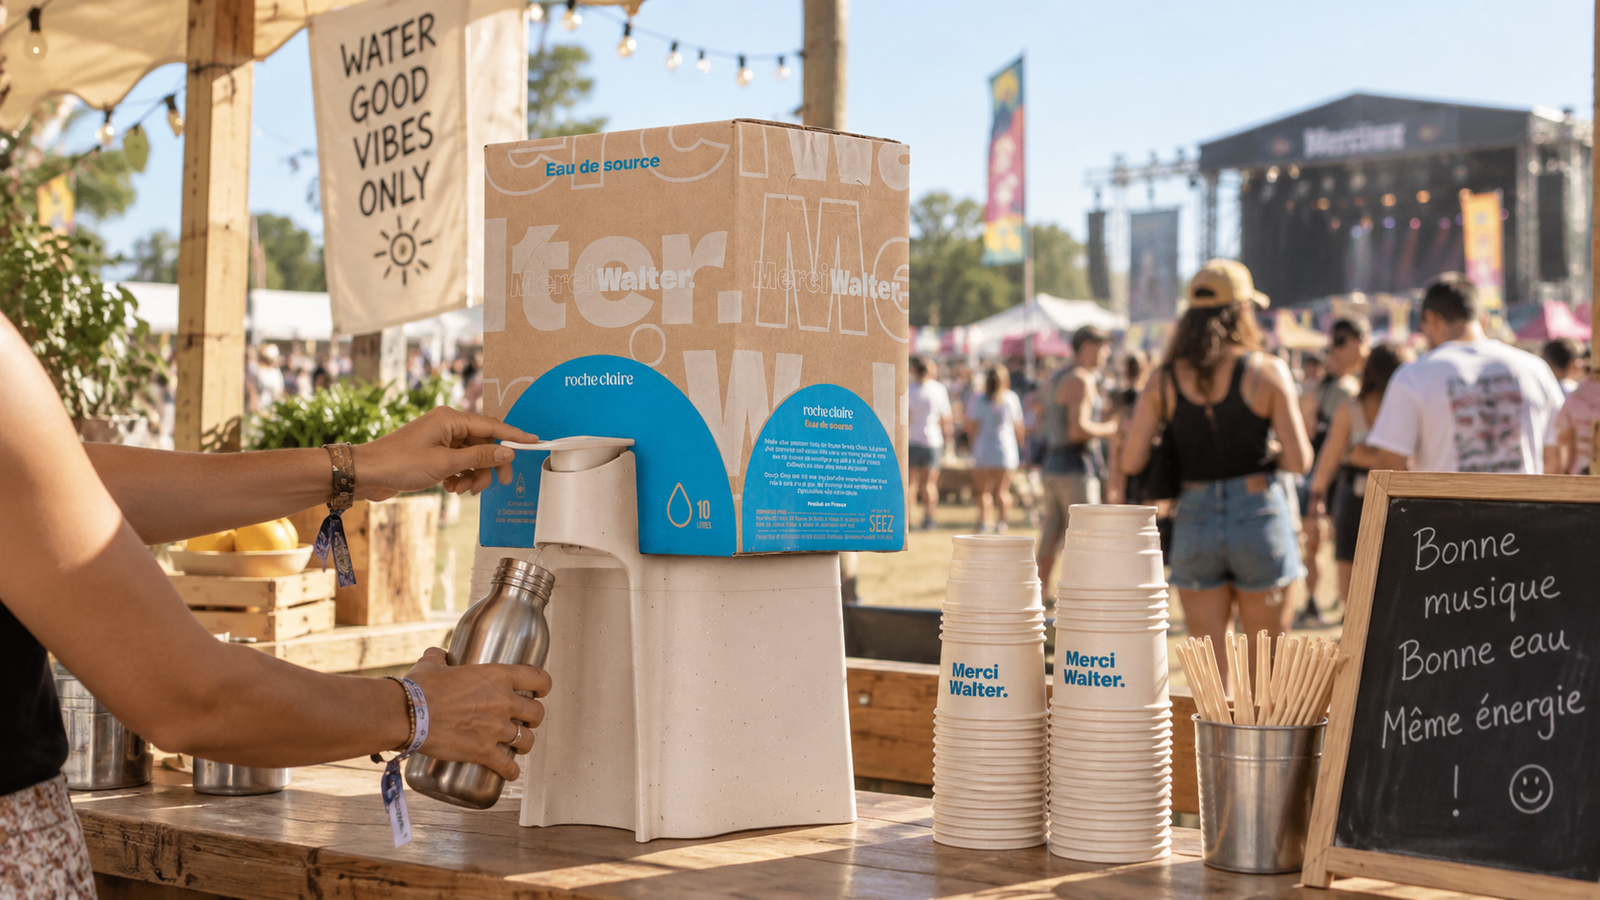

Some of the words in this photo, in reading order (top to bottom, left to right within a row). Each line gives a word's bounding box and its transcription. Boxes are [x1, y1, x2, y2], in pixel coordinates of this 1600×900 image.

[341, 12, 437, 78] WATER
[350, 66, 429, 124] GOOD
[353, 111, 434, 170] VIBES
[546, 162, 575, 177] Eau
[579, 159, 600, 174] de
[603, 156, 661, 172] source
[359, 160, 430, 217] ONLY
[565, 373, 598, 387] roche
[600, 372, 634, 386] claire
[696, 499, 711, 520] 10
[869, 514, 895, 533] SEEZ
[1414, 527, 1519, 572] Bonne
[1424, 576, 1561, 622] musique
[952, 662, 998, 680] Merci
[1067, 650, 1115, 669] Merci
[1399, 639, 1495, 681] Bonne
[1510, 629, 1571, 659] eau
[949, 680, 1009, 699] Walter.
[1064, 669, 1126, 688] Walter.
[1382, 706, 1463, 749] Même
[1475, 685, 1586, 741] énergie
